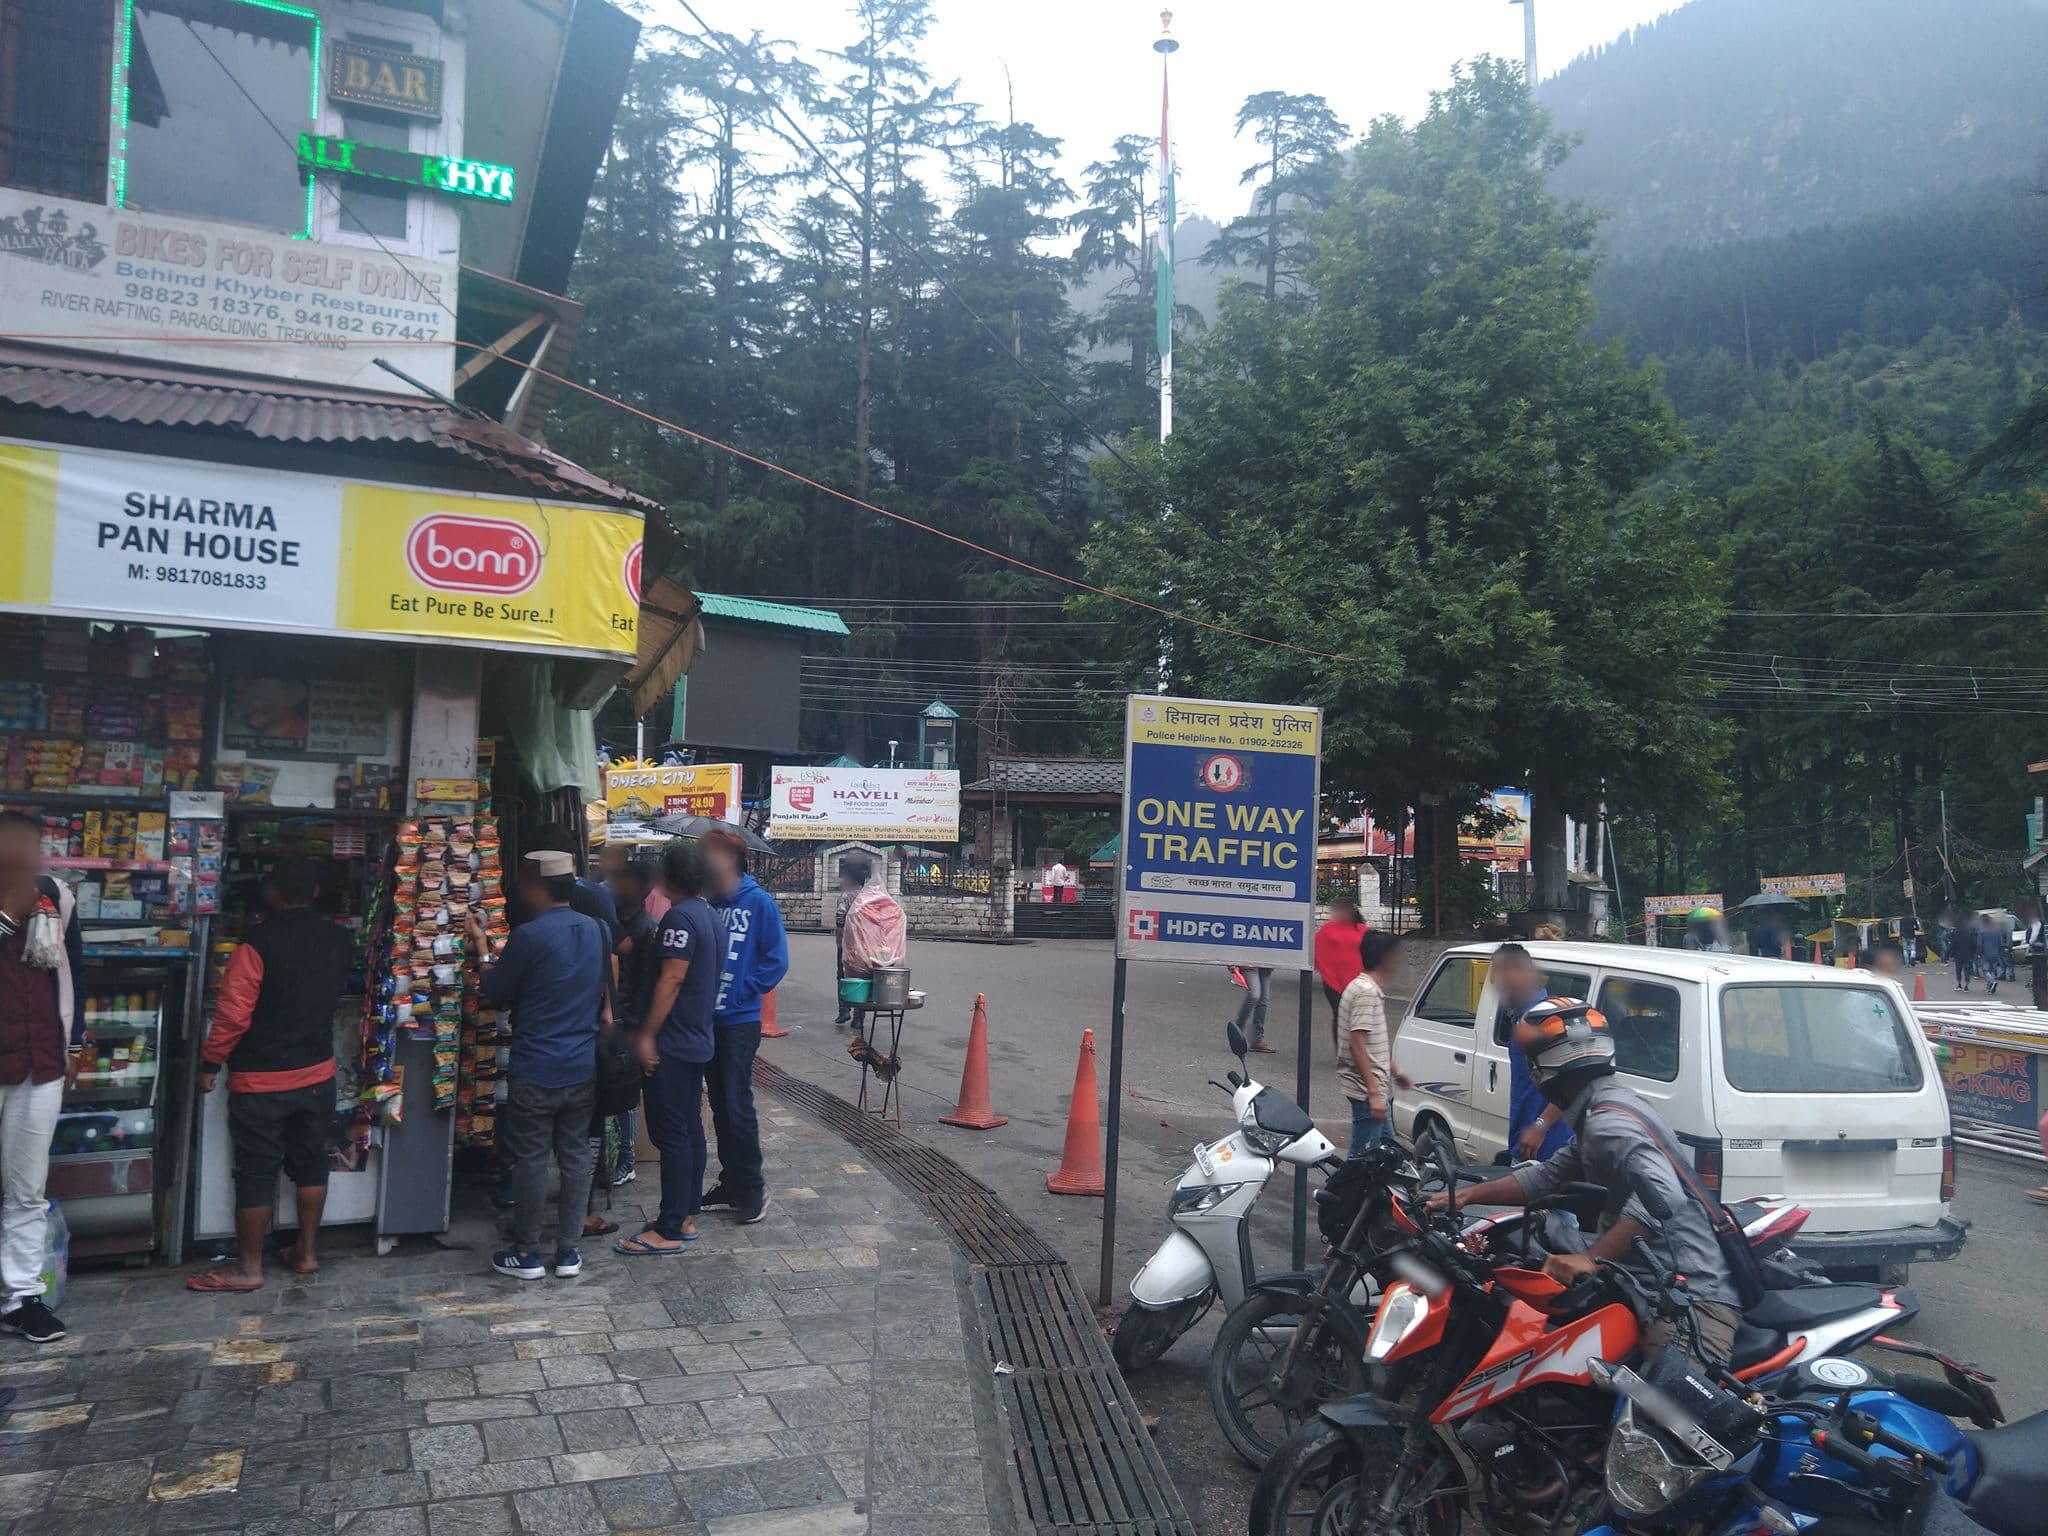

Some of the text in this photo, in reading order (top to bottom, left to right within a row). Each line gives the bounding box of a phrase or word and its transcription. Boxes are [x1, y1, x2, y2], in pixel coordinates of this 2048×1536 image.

[345, 54, 428, 101] BAR
[114, 222, 443, 306] BIKES FOR SELF DRIVE
[115, 260, 441, 326] Behind Khyber Restaurant
[40, 289, 90, 313] RIVER
[93, 298, 165, 327] RAFTING,
[276, 324, 348, 351] TREKKING
[124, 282, 440, 343] 98823 18376, 94182 67447
[123, 491, 278, 532] SHARMA
[97, 521, 301, 567] PAN HOUSE
[426, 528, 527, 577] bonn
[127, 563, 267, 590] M: 9817081833
[389, 593, 555, 624] Eat Pure Be Sure..!
[611, 613, 635, 632] Eat
[1165, 705, 1314, 736] हिमाचल प्रदेश पुलिस
[1146, 730, 1303, 750] Police Helpline No. 01902-252326
[610, 773, 659, 789] OMEGA
[662, 771, 696, 786] CITY
[833, 790, 899, 800] HAVELI
[1137, 797, 1305, 835] ONE WAY
[1138, 832, 1299, 870] TRAFFIC
[1187, 877, 1210, 888] स्वच्छ
[1212, 879, 1232, 890] भारत
[1261, 882, 1282, 893] भारत
[663, 928, 689, 948] 03
[1166, 919, 1295, 943] HDFC BANK
[1975, 1048, 2029, 1078] FOR
[1945, 1070, 2031, 1103] CKING
[1685, 1375, 1714, 1399] SUZUKI
